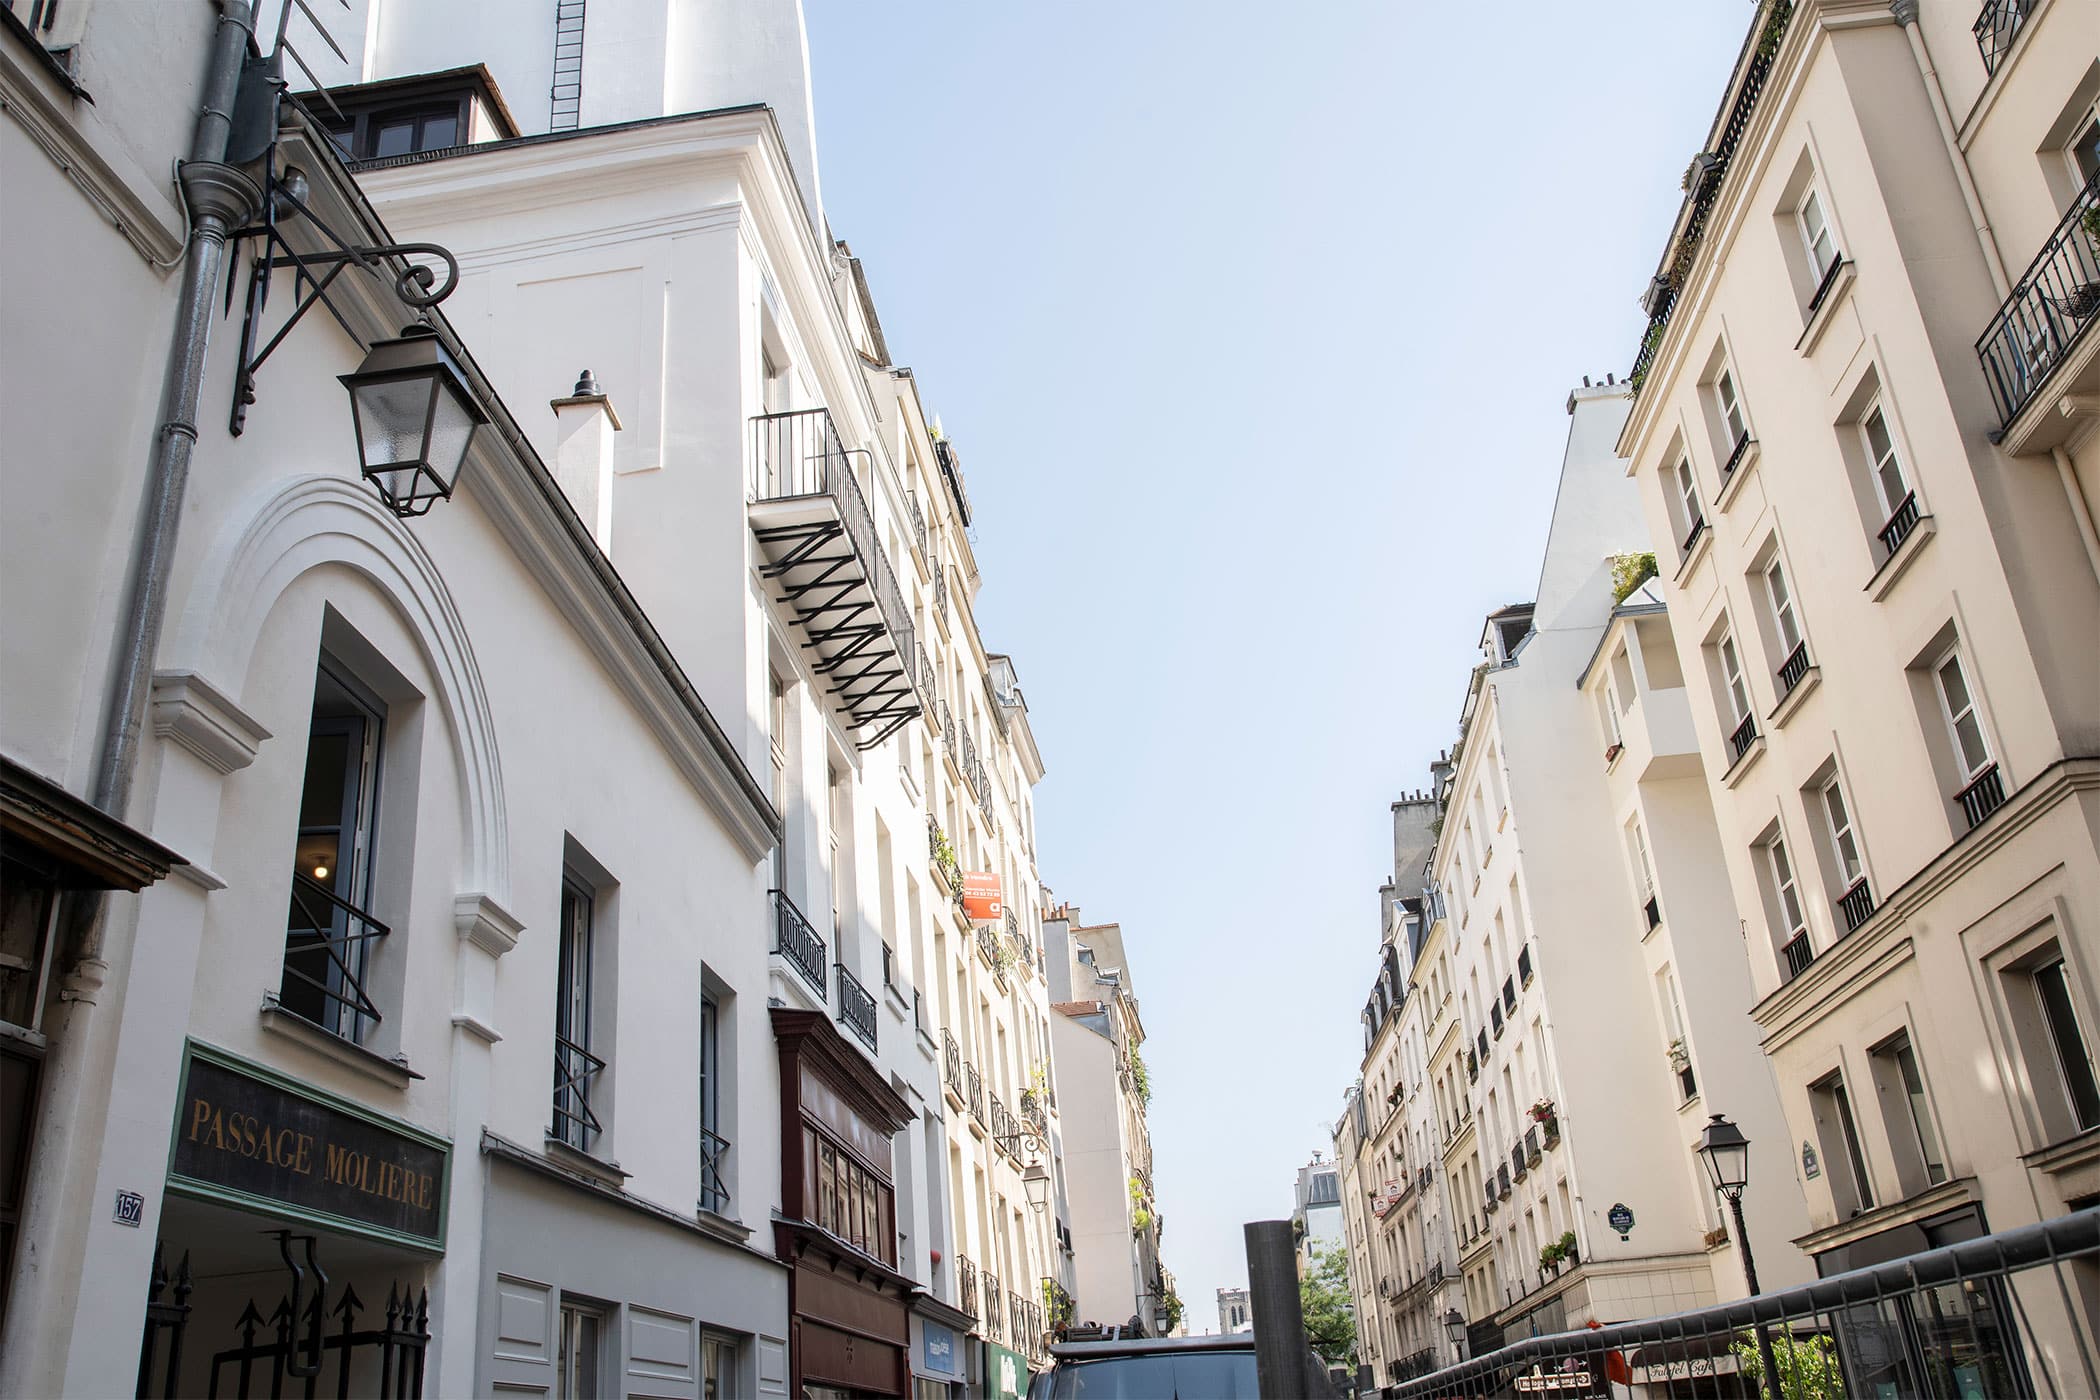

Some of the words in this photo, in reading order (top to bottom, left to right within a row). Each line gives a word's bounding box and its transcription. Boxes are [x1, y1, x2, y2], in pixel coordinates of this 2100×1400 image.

[188, 1098, 313, 1175] PASSAGE
[324, 1143, 433, 1210] MOLIERE
[118, 1196, 141, 1220] 157
[1522, 1378, 1545, 1389] Hologe
